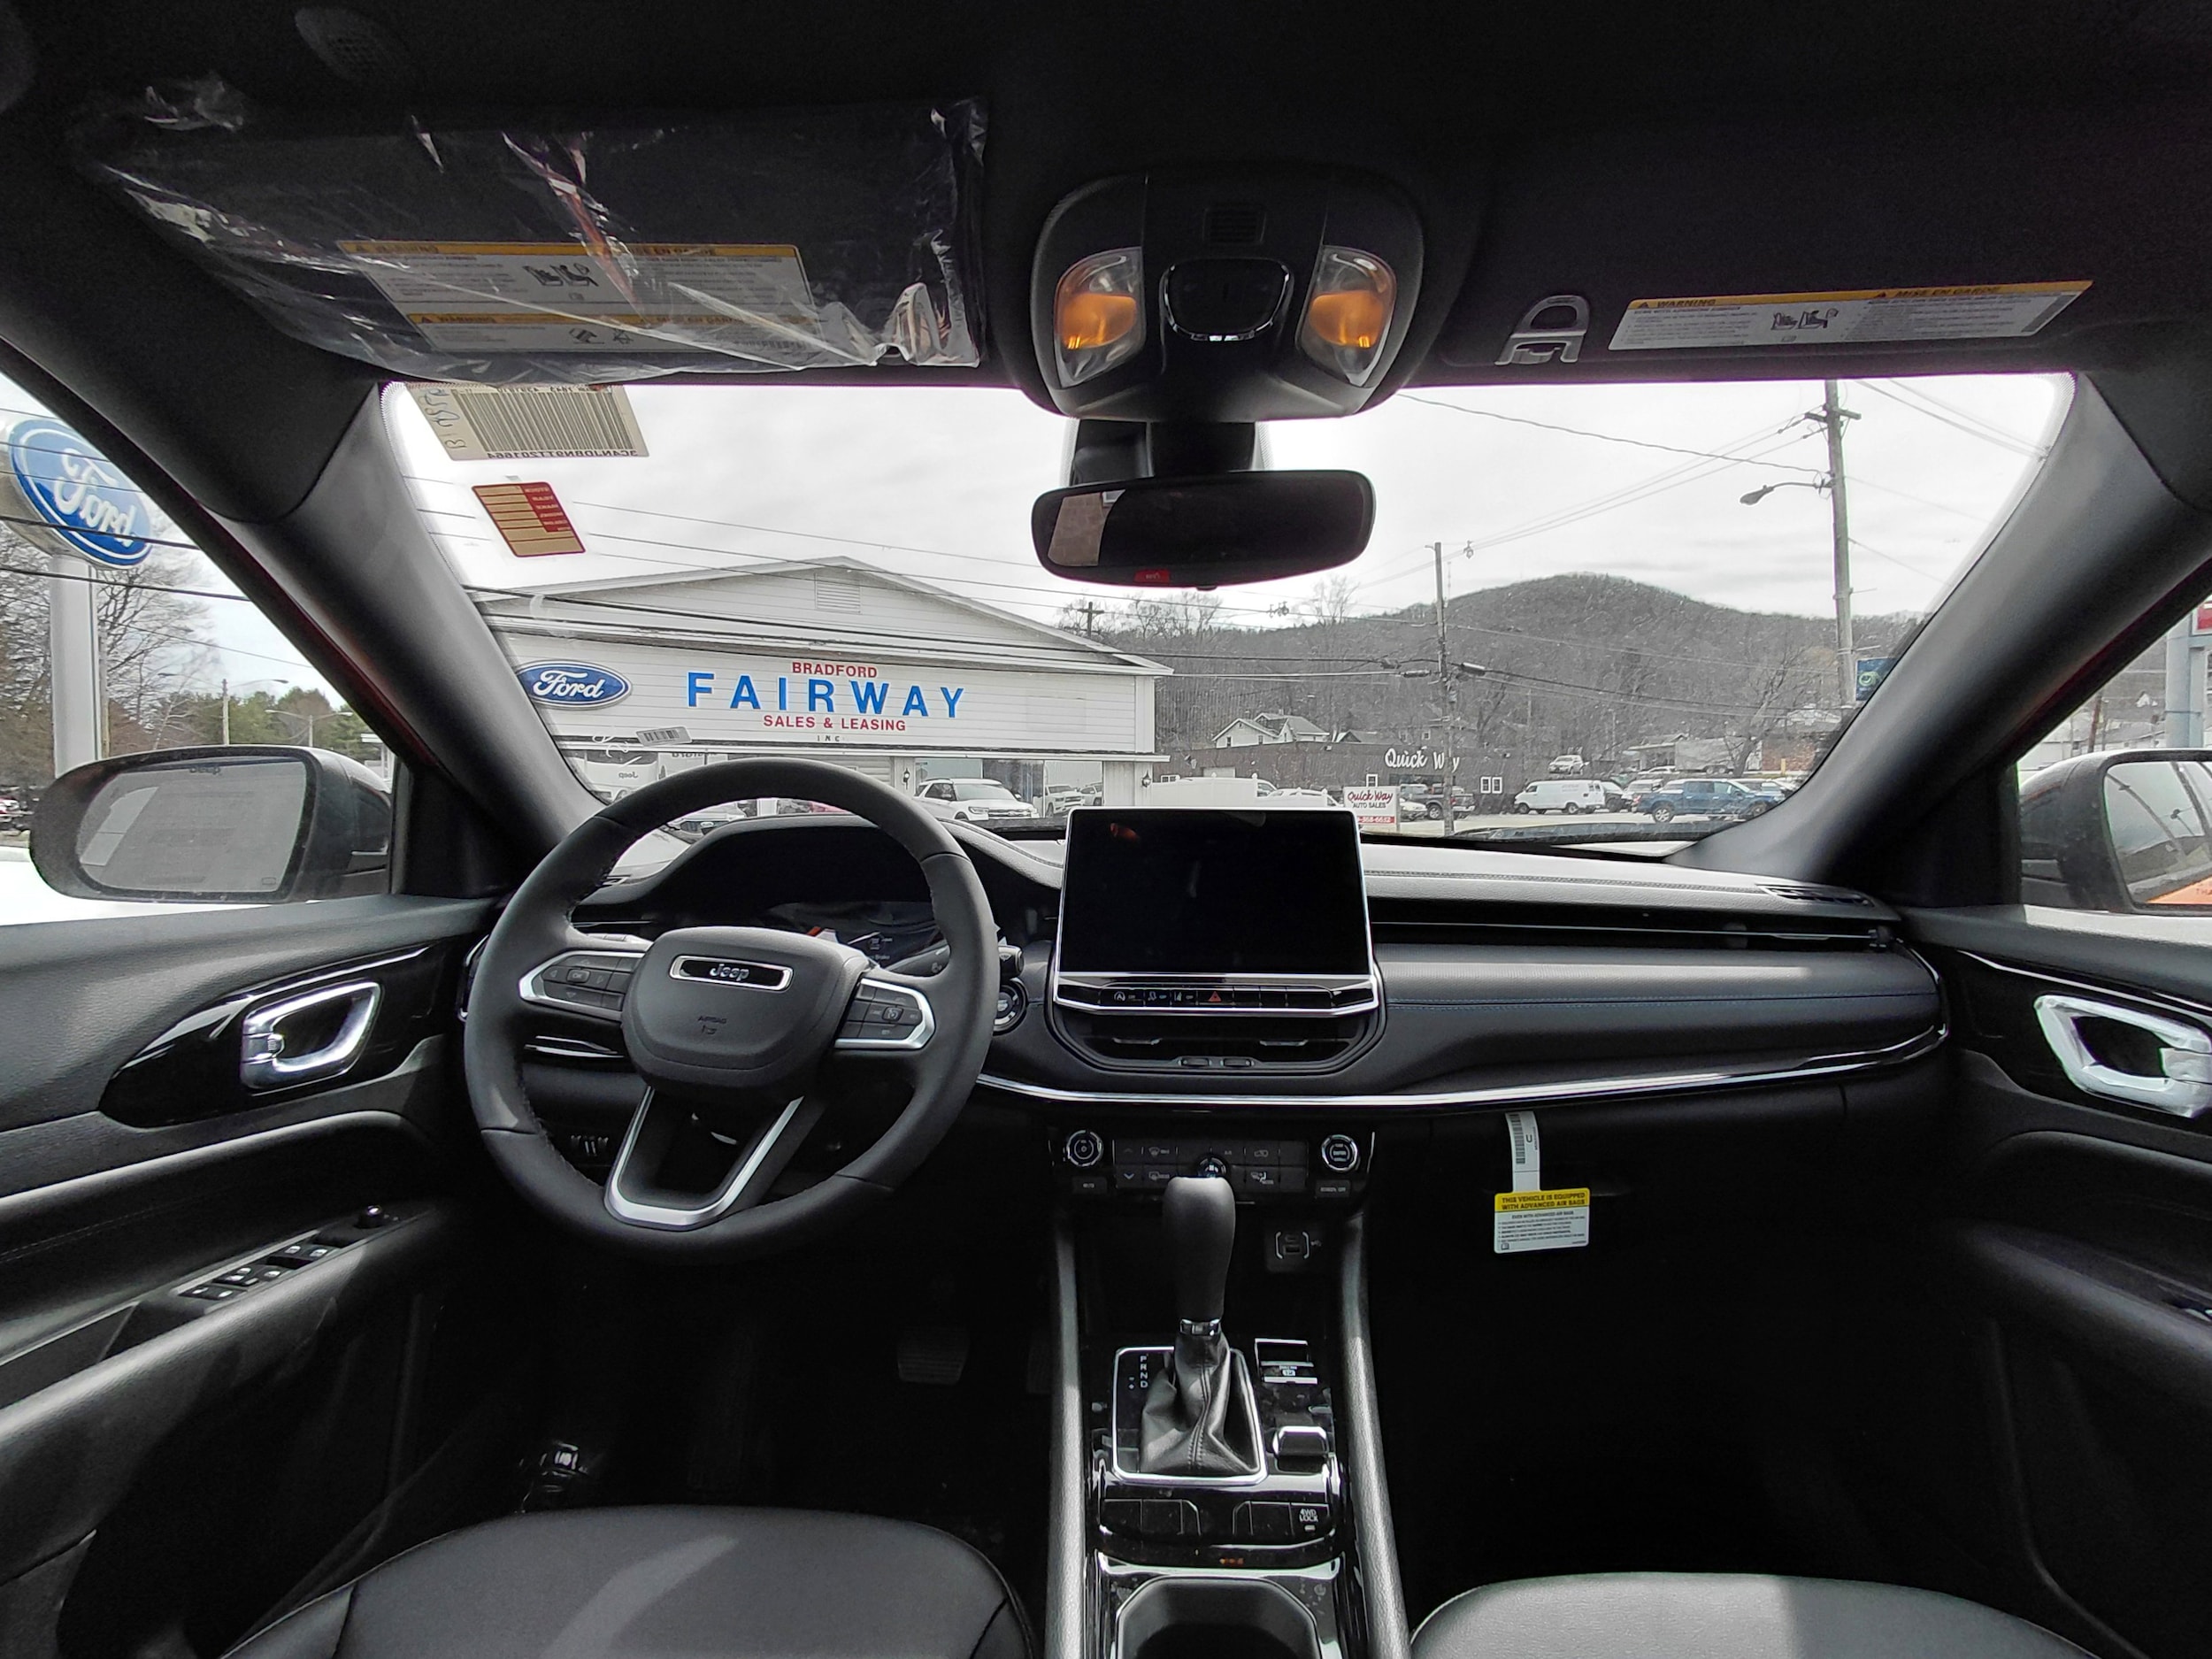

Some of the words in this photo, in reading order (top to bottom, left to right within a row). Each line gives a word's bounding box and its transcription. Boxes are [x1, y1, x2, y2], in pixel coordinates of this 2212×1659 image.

[53, 448, 138, 548] Ford
[792, 661, 878, 679] BRADFORD
[533, 670, 606, 698] Ford
[687, 671, 964, 718] FAIRWAY
[763, 714, 816, 728] SALES
[823, 718, 833, 728] &
[841, 718, 906, 732] LEASING
[1385, 748, 1428, 768] Quick
[1433, 751, 1460, 773] Wy
[1348, 790, 1373, 802] Quick
[1373, 790, 1394, 803] Way
[709, 963, 750, 981] Jeep
